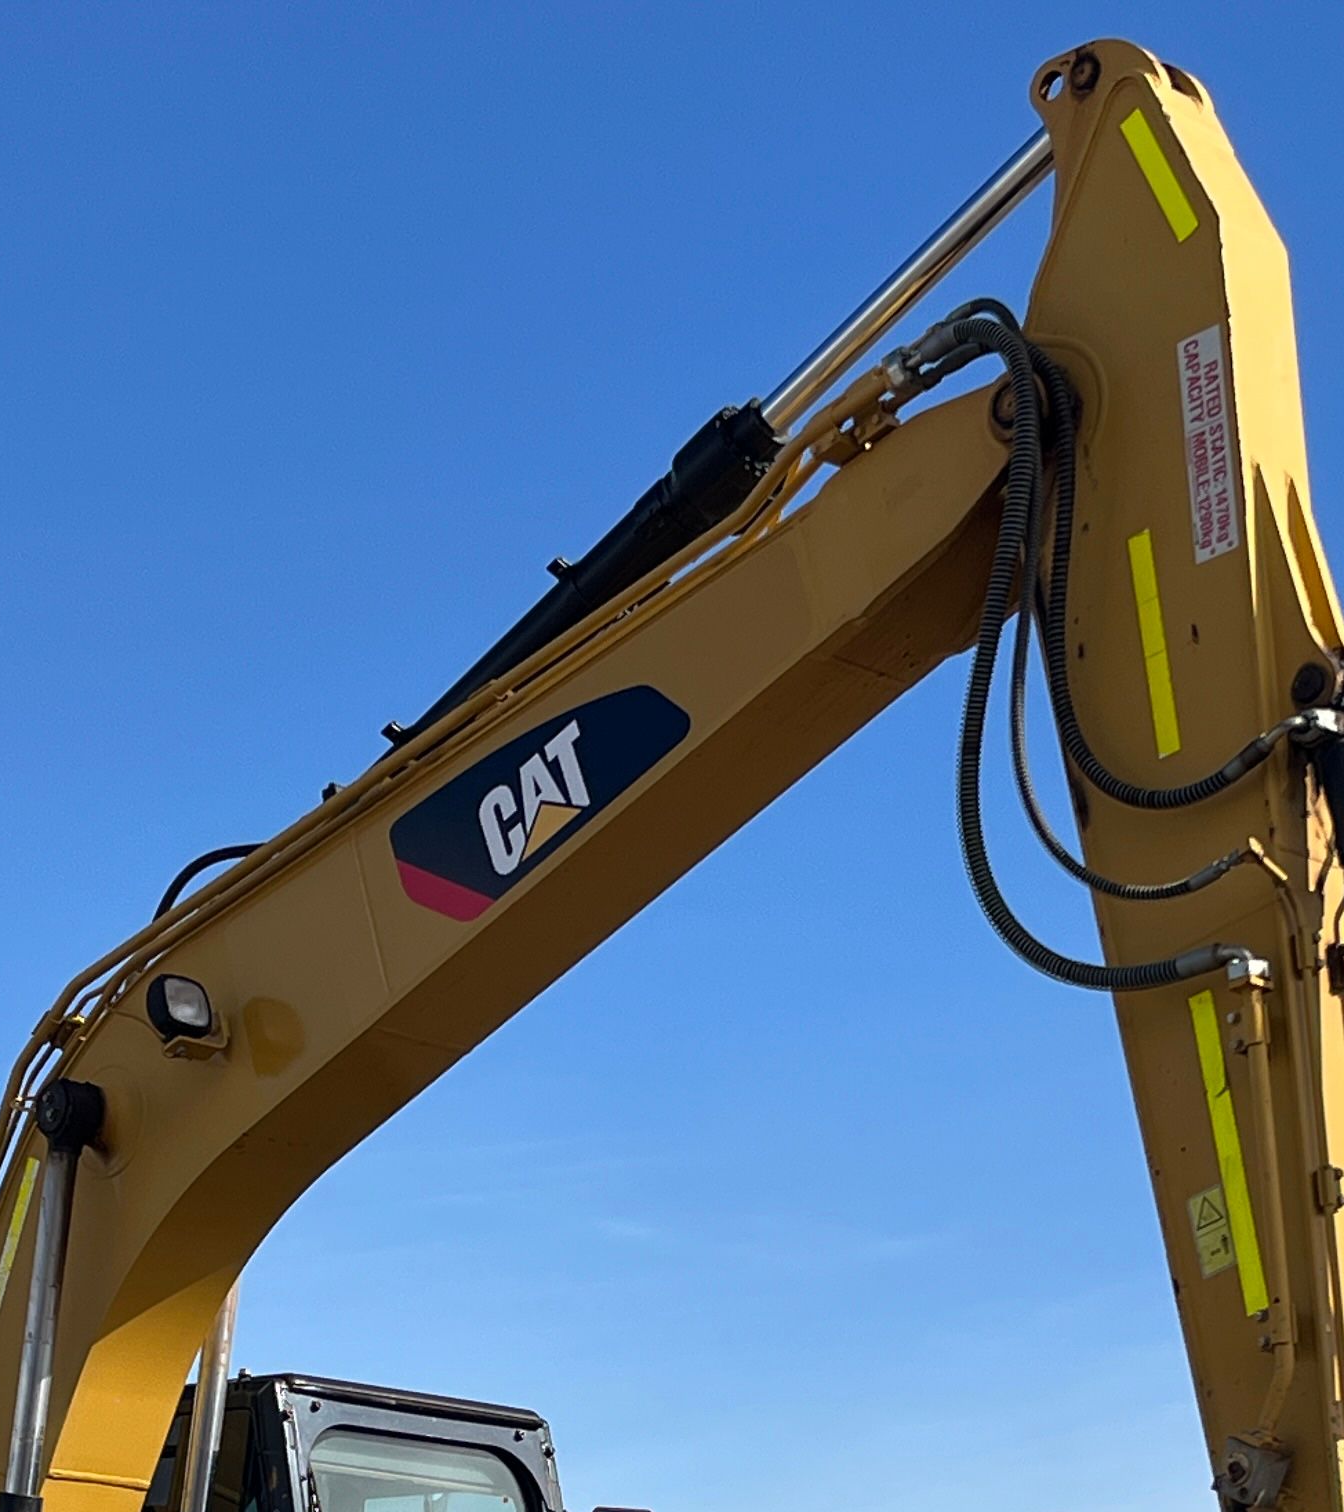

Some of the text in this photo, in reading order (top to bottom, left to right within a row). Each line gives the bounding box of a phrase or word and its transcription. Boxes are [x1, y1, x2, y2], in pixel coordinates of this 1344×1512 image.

[1183, 338, 1205, 425] CAPACITY
[1204, 358, 1223, 419] RATED
[478, 718, 591, 876] CAT
